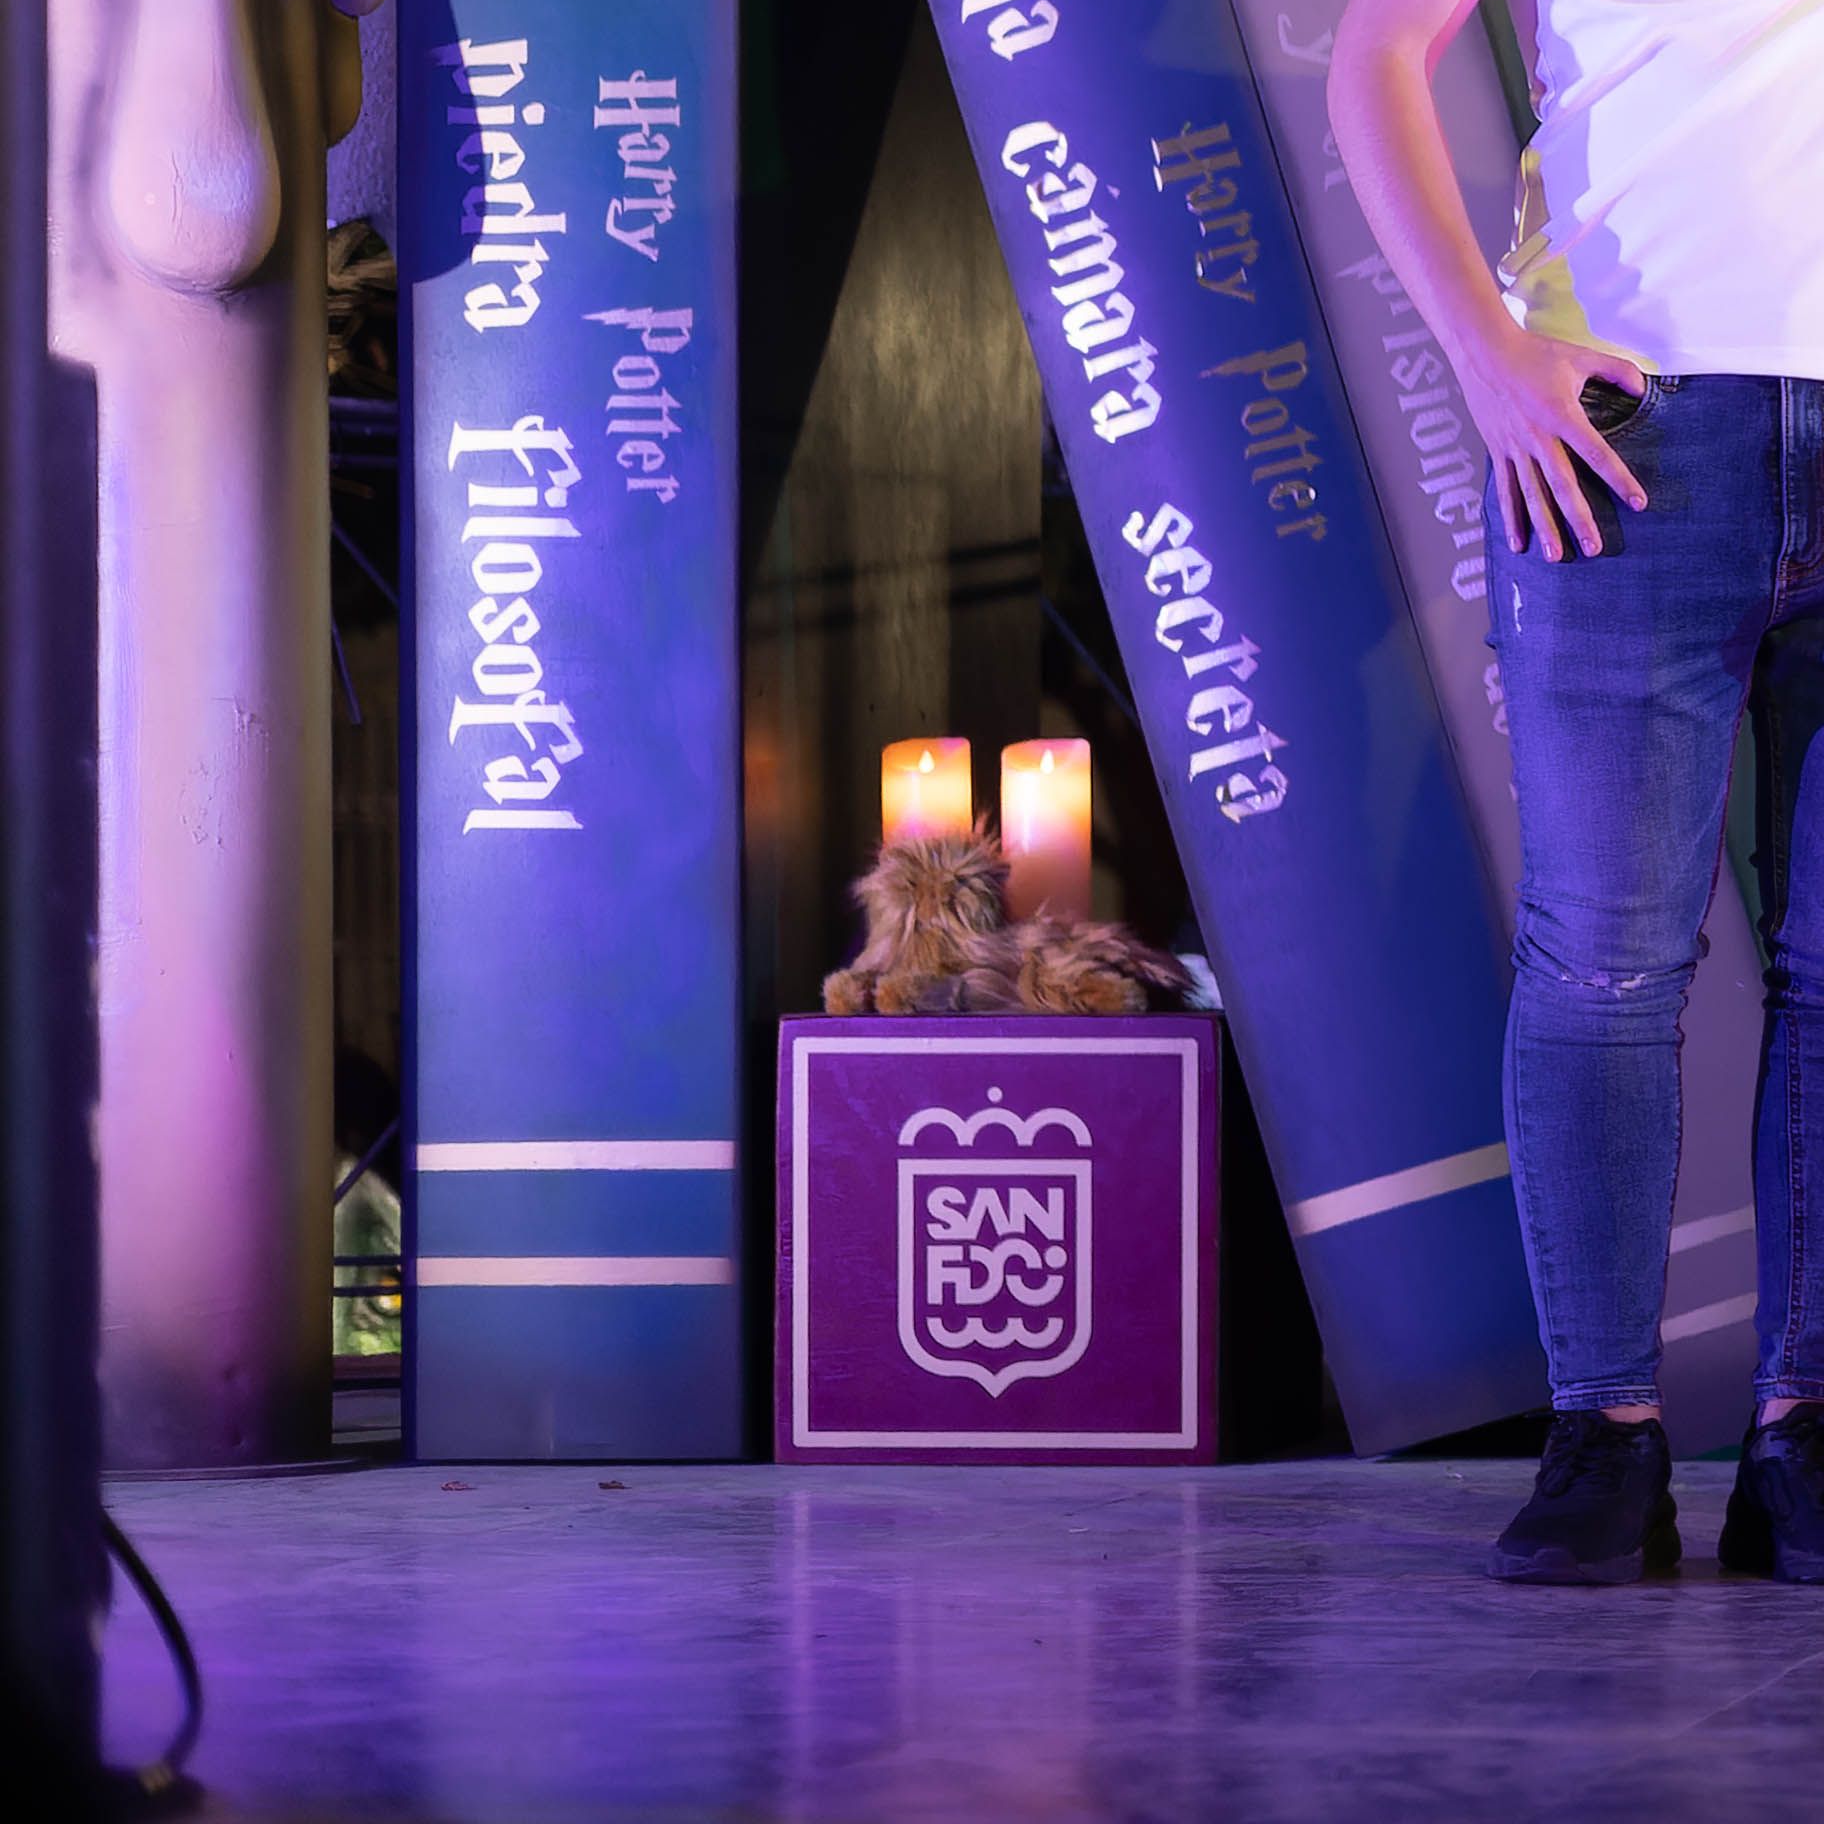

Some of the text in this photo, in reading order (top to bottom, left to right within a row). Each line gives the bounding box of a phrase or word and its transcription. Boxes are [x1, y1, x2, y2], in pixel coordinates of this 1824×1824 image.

[425, 38, 567, 334] piedra
[581, 69, 694, 503] Harry Potter
[1151, 122, 1328, 542] Harry Potter
[448, 415, 584, 835] filosofal
[1121, 502, 1290, 824] secreta
[926, 1185, 1065, 1242] SAN
